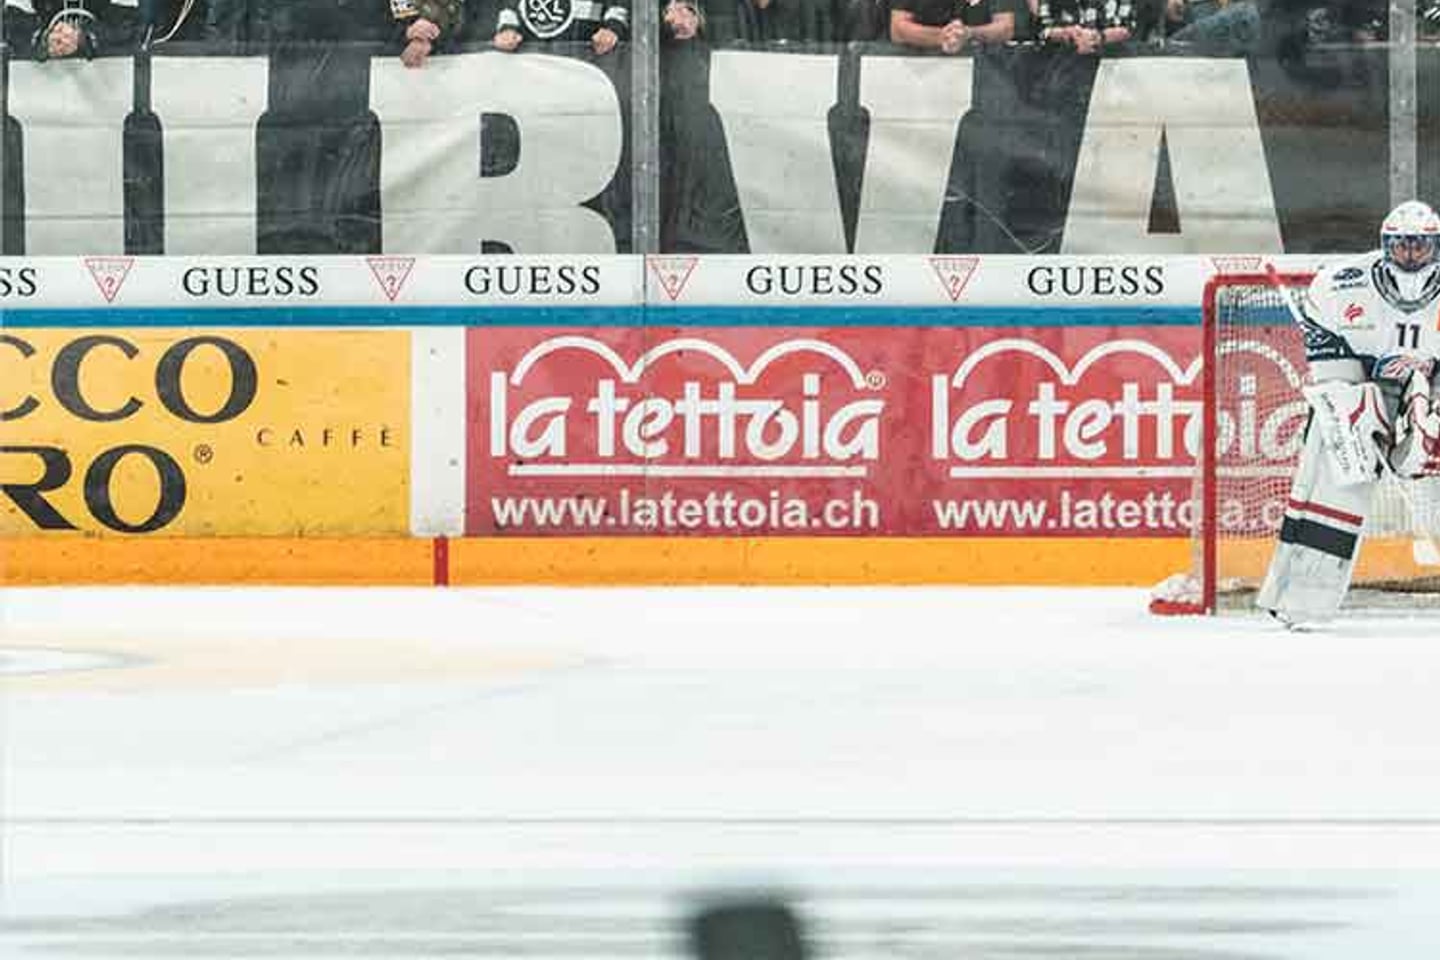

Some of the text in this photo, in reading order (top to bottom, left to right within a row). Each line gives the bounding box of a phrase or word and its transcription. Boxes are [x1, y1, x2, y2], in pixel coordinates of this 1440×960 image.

[182, 266, 319, 297] GUESS
[464, 266, 600, 295] GUESS
[746, 266, 882, 295] GUESS
[1027, 266, 1164, 295] GUESS
[1396, 323, 1421, 350] 11
[491, 371, 885, 460] la tettoia
[932, 373, 1013, 460] la
[491, 489, 879, 528] www.latettoia.ch
